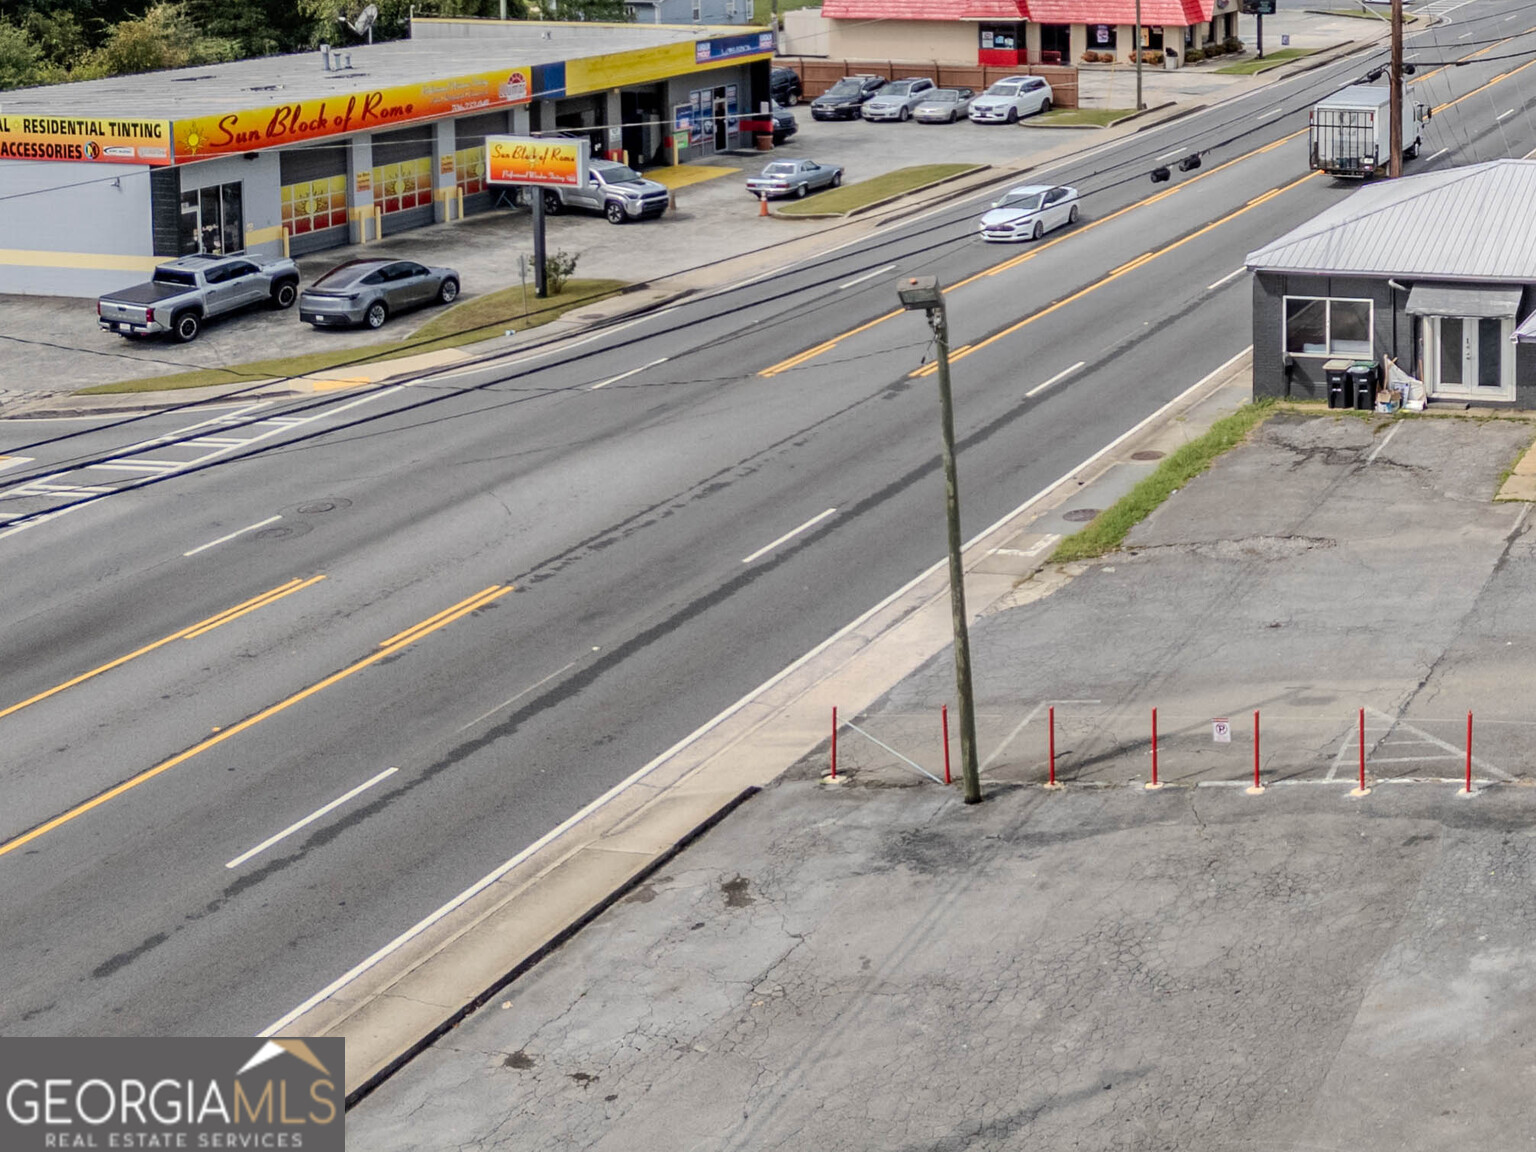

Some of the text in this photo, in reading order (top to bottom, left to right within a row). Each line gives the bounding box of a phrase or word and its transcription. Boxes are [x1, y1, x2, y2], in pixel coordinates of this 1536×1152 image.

[23, 118, 105, 136] RESIDENTIAL
[109, 122, 162, 138] TINTING
[210, 114, 260, 147] Sun
[266, 104, 327, 138] Block
[333, 96, 356, 132] of
[362, 91, 414, 121] Rome
[0, 141, 82, 159] ACCESSORIES
[491, 144, 575, 165] Sun Block of Rome
